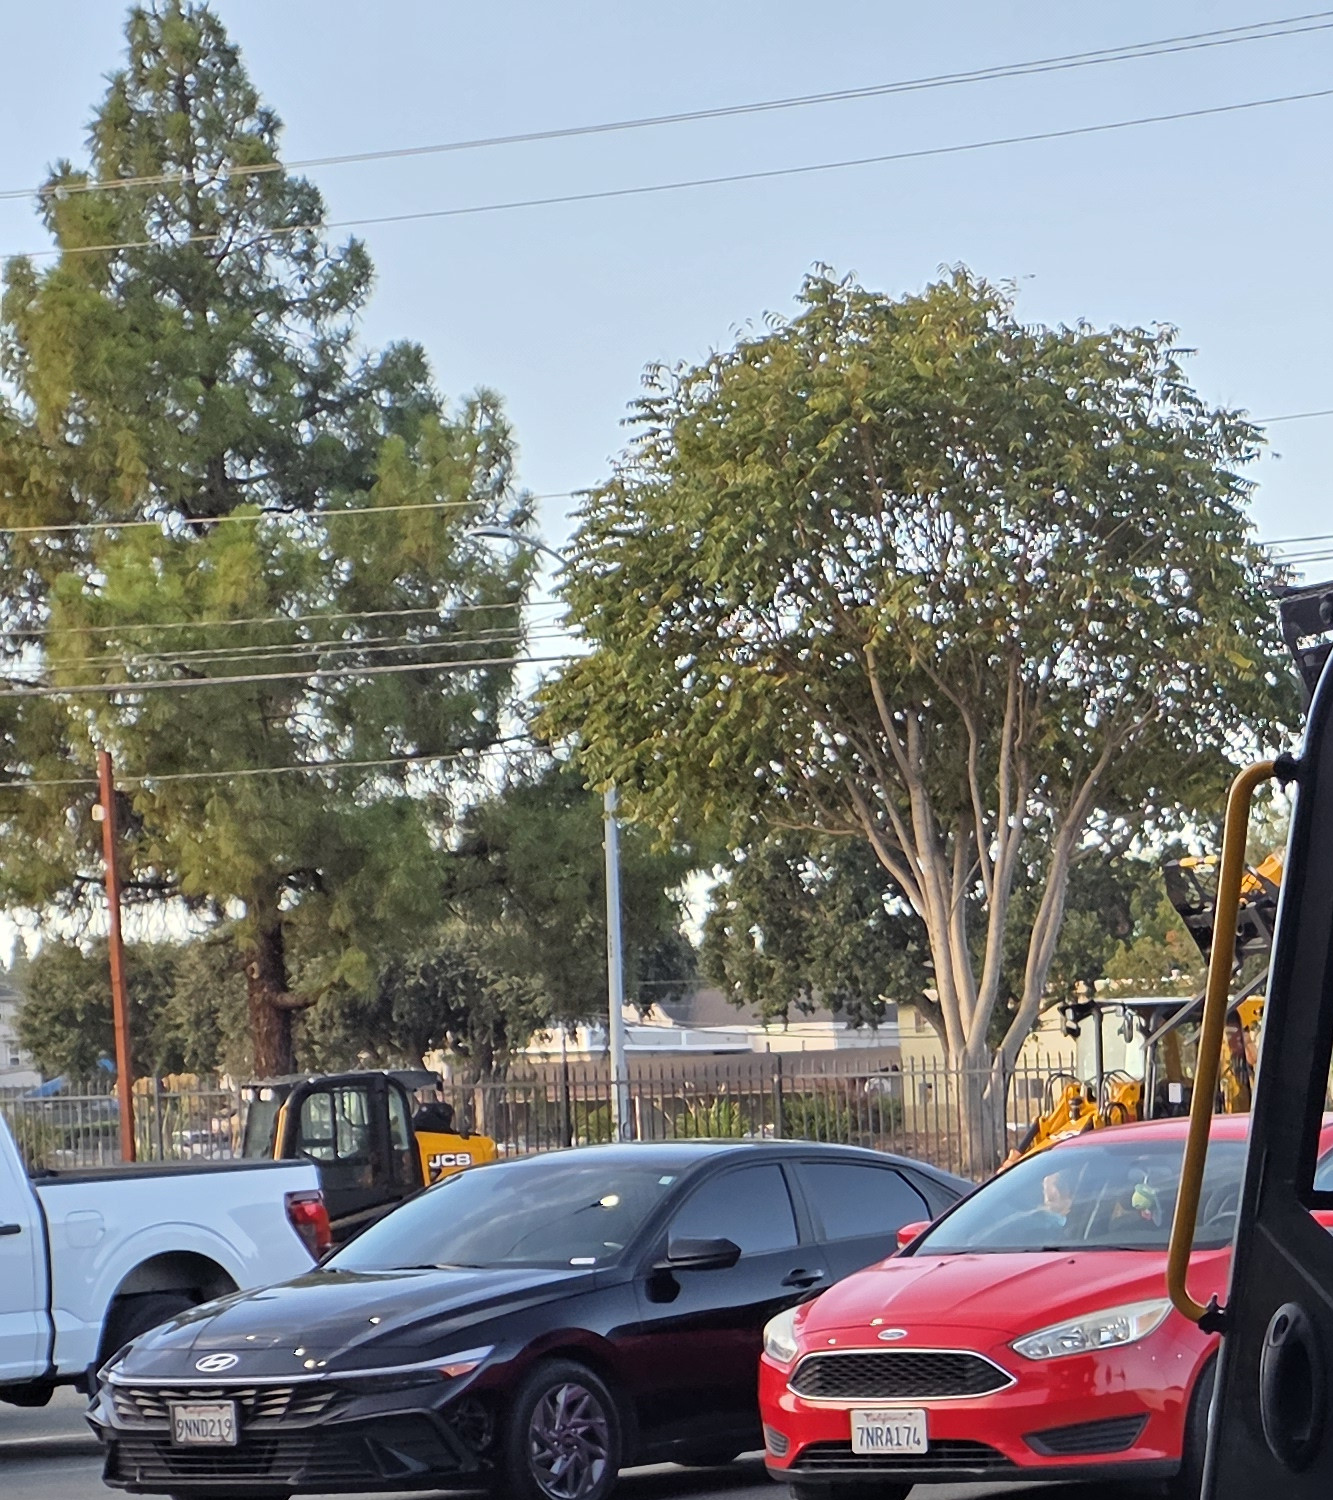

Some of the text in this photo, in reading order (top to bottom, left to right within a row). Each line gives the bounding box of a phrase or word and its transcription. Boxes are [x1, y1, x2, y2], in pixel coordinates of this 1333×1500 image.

[428, 1153, 471, 1169] JCB
[177, 1418, 231, 1438] 9NND219
[857, 1426, 921, 1447] 7NRA174
